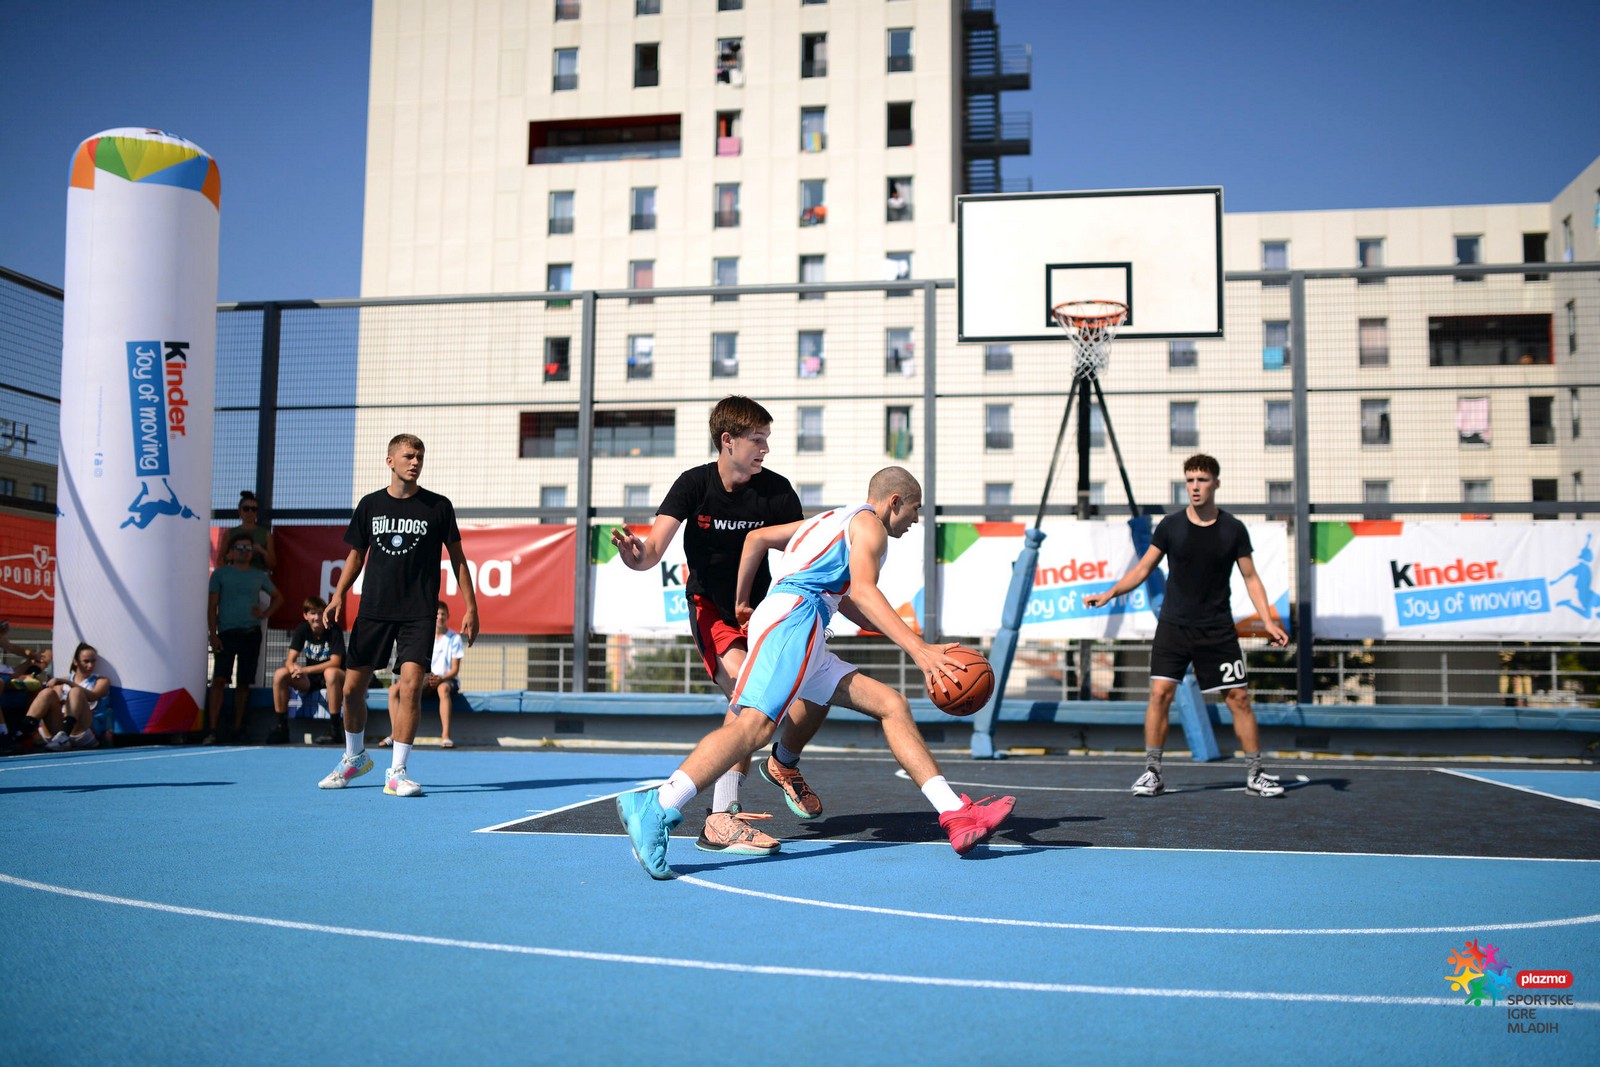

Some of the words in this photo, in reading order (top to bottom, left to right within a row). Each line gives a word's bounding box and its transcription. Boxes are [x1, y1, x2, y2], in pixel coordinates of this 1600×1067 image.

[133, 346, 156, 380] Joy
[138, 383, 160, 403] of
[140, 407, 162, 470] moving
[372, 518, 428, 535] BULLDOGS
[1058, 590, 1077, 612] of
[1403, 597, 1440, 620] Joy
[1444, 591, 1465, 614] of
[1469, 587, 1543, 611] moving
[1219, 659, 1246, 683] 20
